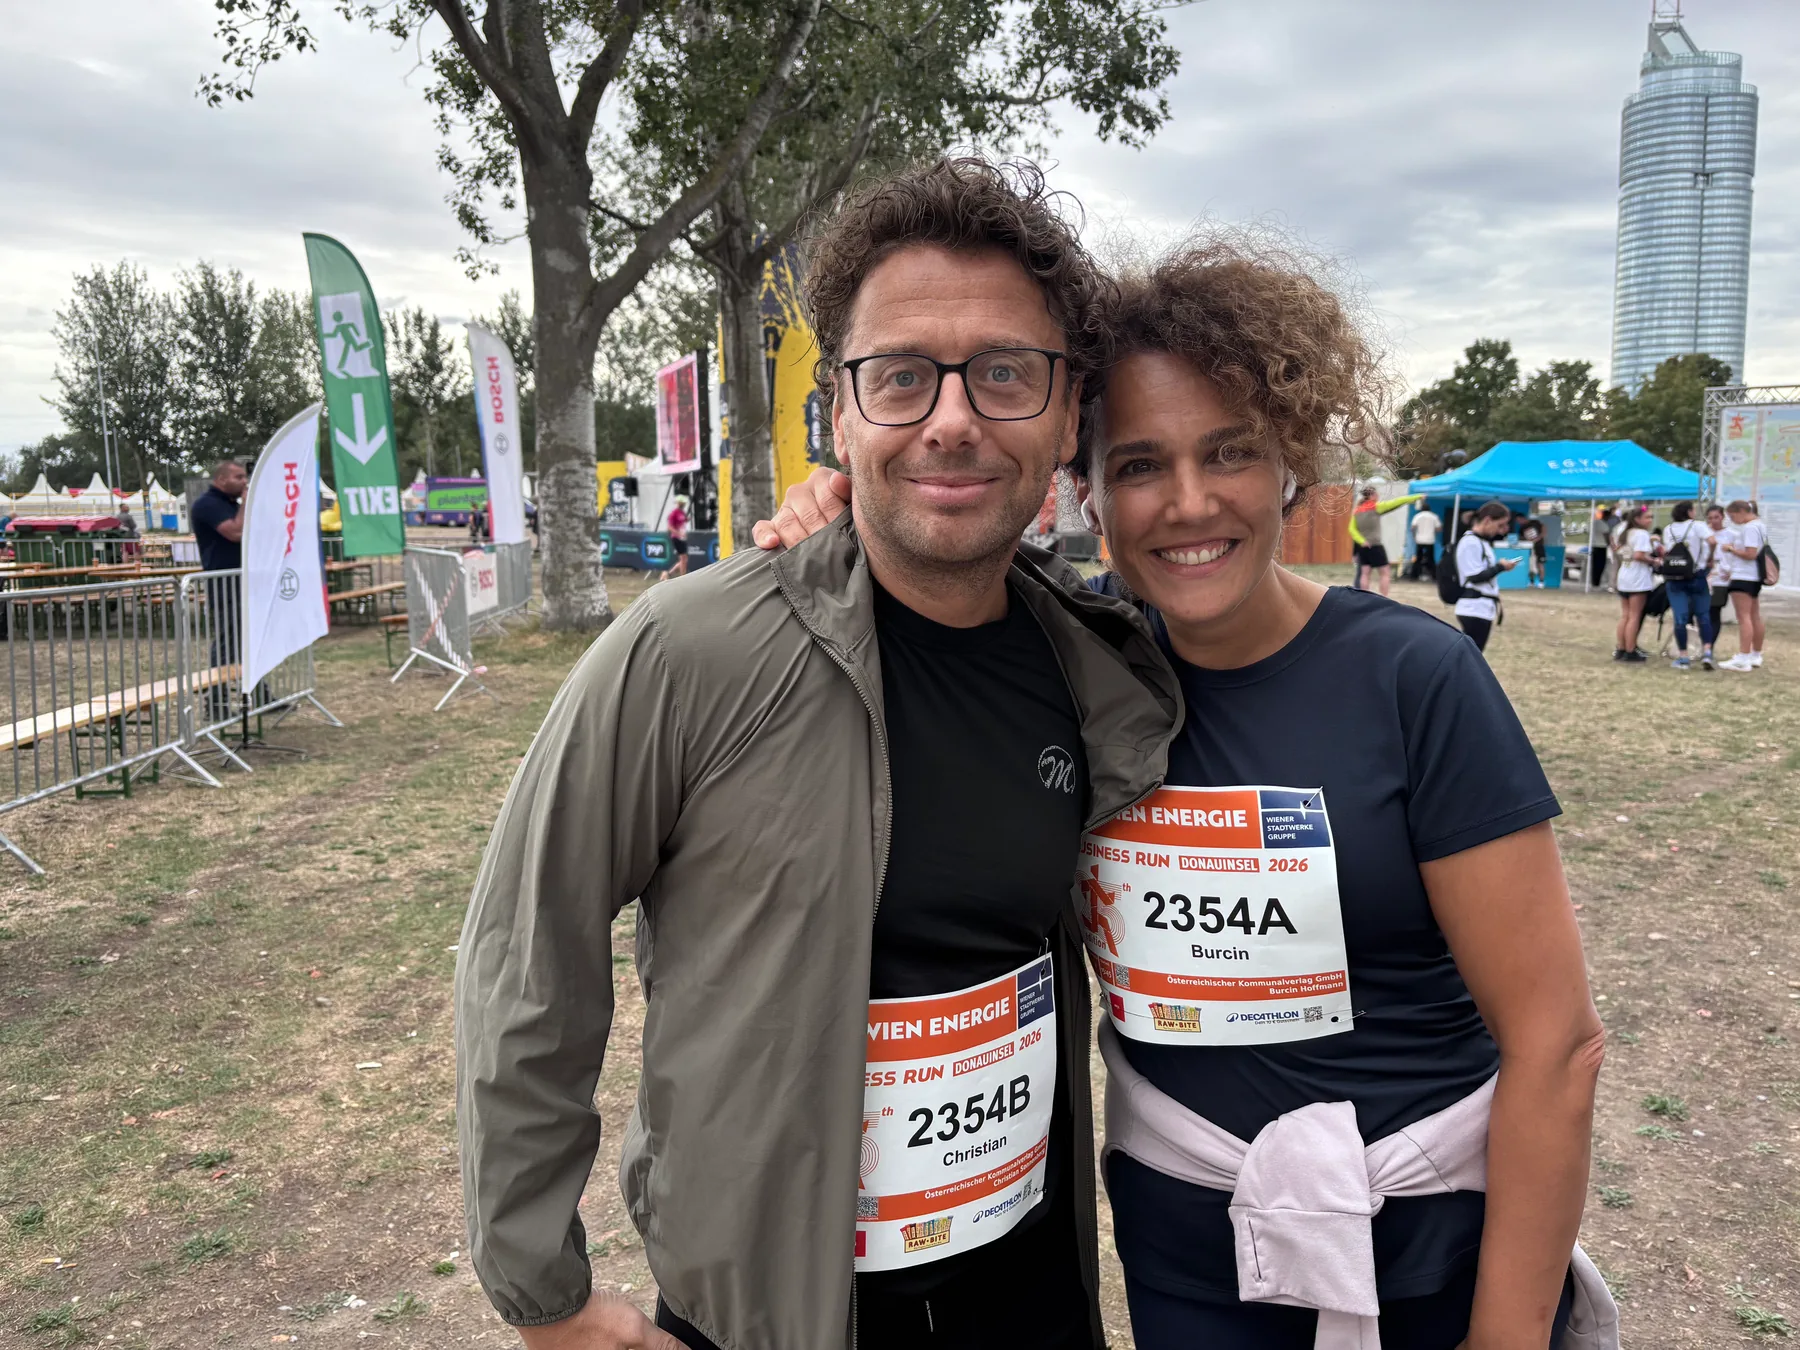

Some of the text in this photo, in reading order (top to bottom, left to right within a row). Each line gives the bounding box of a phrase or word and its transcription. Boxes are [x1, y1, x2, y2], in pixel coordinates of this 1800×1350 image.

[1547, 458, 1608, 469] EGYM
[1115, 805, 1248, 828] EN ENERGIE
[1266, 815, 1294, 823] WIENER
[1267, 824, 1314, 832] STADTWERKE
[1268, 832, 1296, 840] GRUPPE
[1080, 841, 1308, 872] USINESS RUN DONAUINSEL 2026
[1143, 890, 1298, 936] 2354A
[1191, 944, 1250, 960] Burcin
[1167, 973, 1343, 987] Österreichischer Kommunalverlag GmbH
[1269, 981, 1344, 995] Burcin Hoffmann
[1019, 991, 1036, 1003] WIENER
[867, 996, 1010, 1041] WIEN ENERGIE
[1240, 1010, 1299, 1021] DECATHLON
[903, 1064, 945, 1085] RUN
[955, 1042, 1014, 1075] DONAUINSEL
[1019, 1027, 1042, 1051] 2026
[881, 1106, 894, 1117] th
[907, 1074, 1031, 1148] 2354B
[943, 1135, 1007, 1167] Christian
[924, 1176, 987, 1200] Österreichischer
[987, 1151, 1034, 1181] Kommunalverlag
[993, 1169, 1019, 1187] Christian
